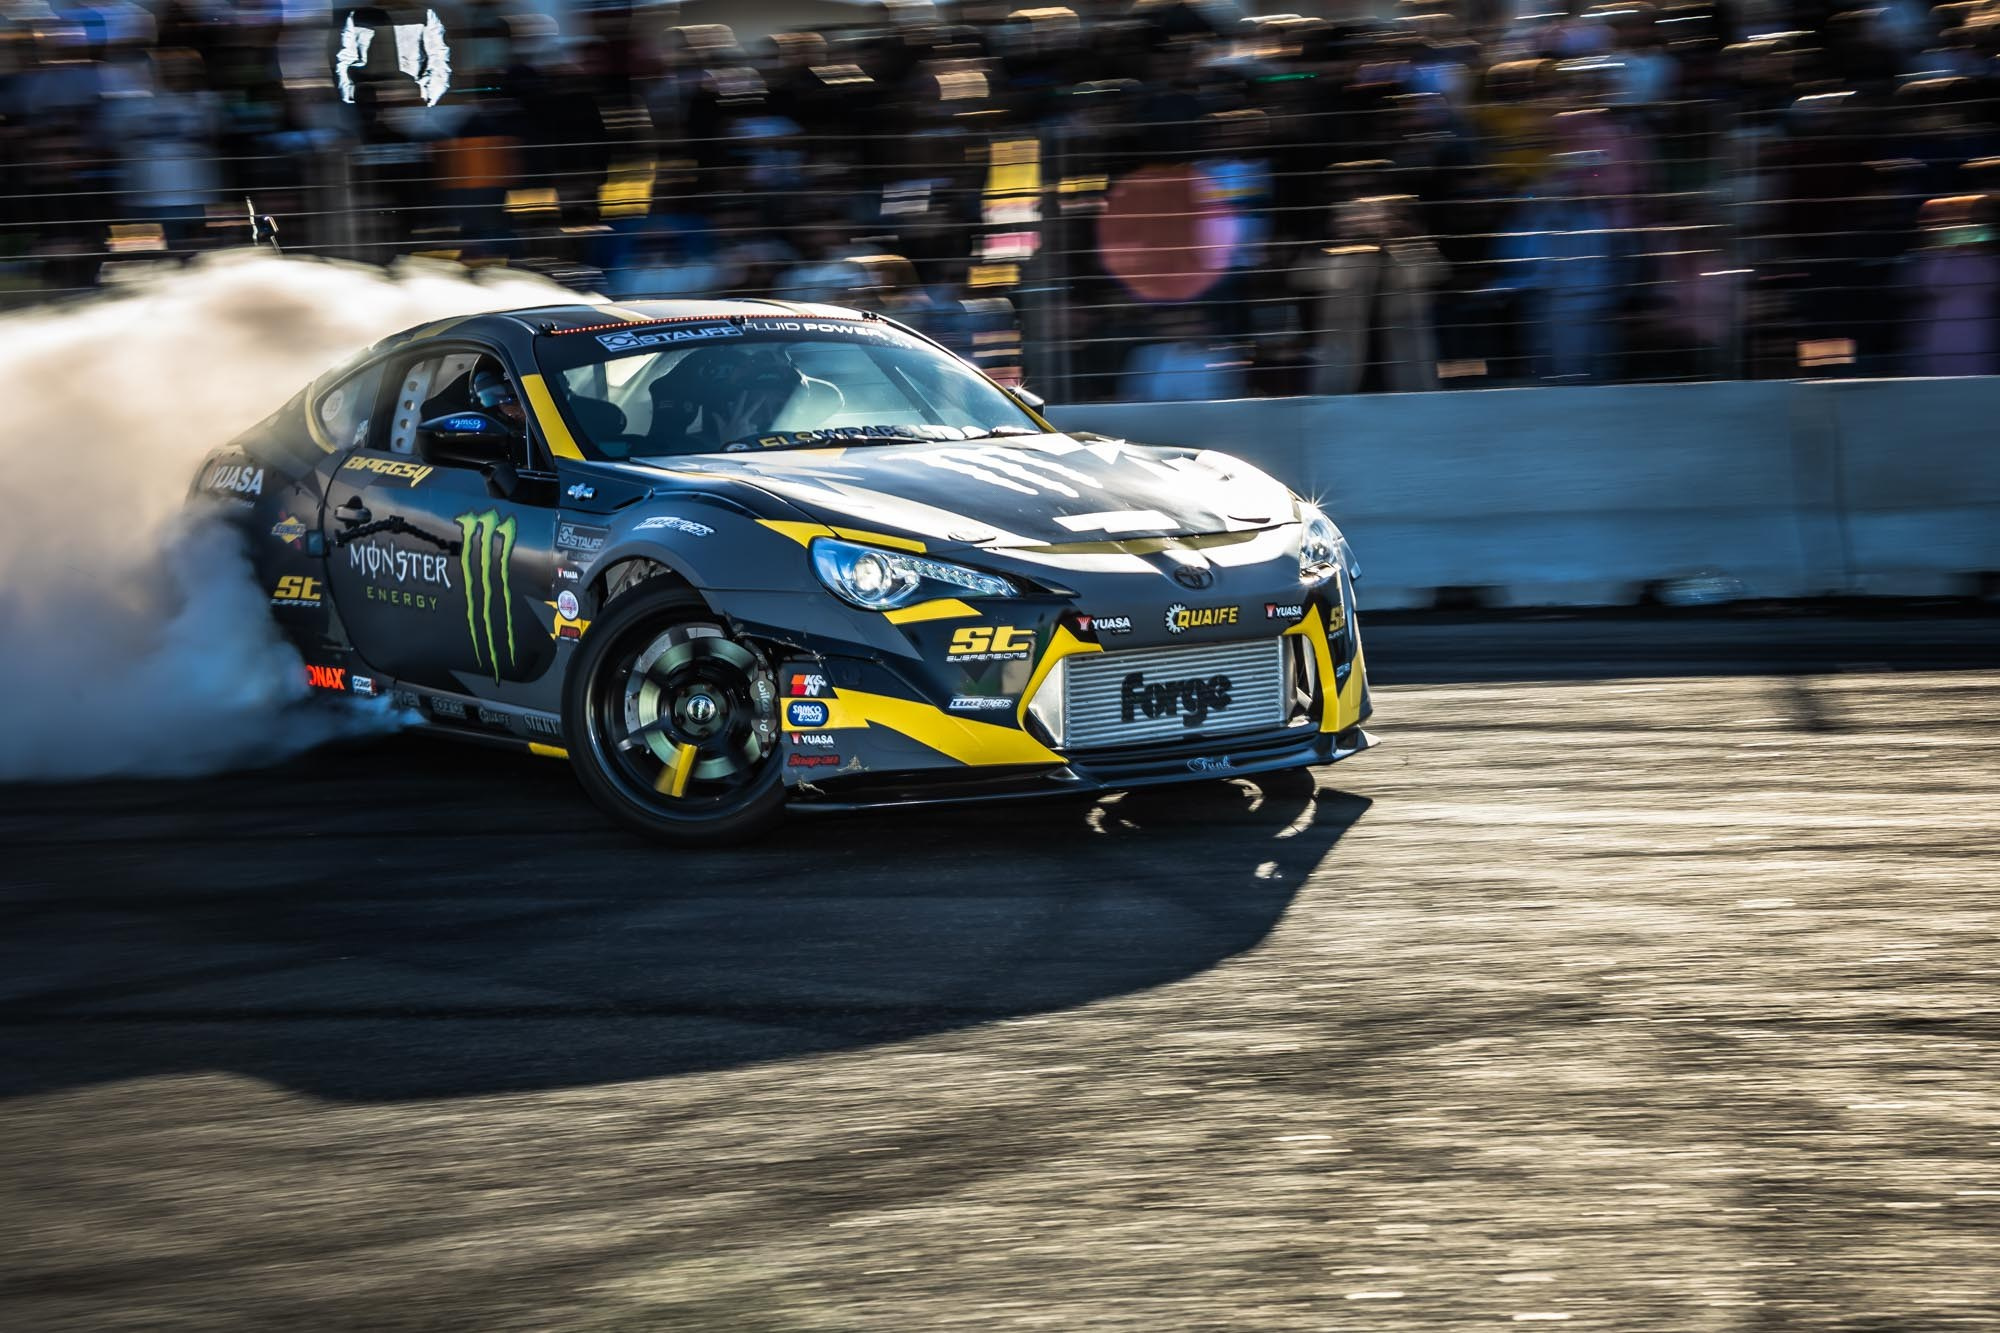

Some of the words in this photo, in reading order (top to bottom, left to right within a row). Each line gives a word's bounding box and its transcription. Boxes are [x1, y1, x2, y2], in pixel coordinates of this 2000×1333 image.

[639, 326, 736, 344] STAUFF
[742, 321, 800, 332] FLUID
[569, 533, 604, 549] STAUFF
[367, 586, 438, 610] ENERGY
[1177, 607, 1239, 629] QUAIFE
[1276, 605, 1303, 617] YUASA
[1091, 617, 1131, 630] YUASA
[801, 735, 834, 745] YUASA
